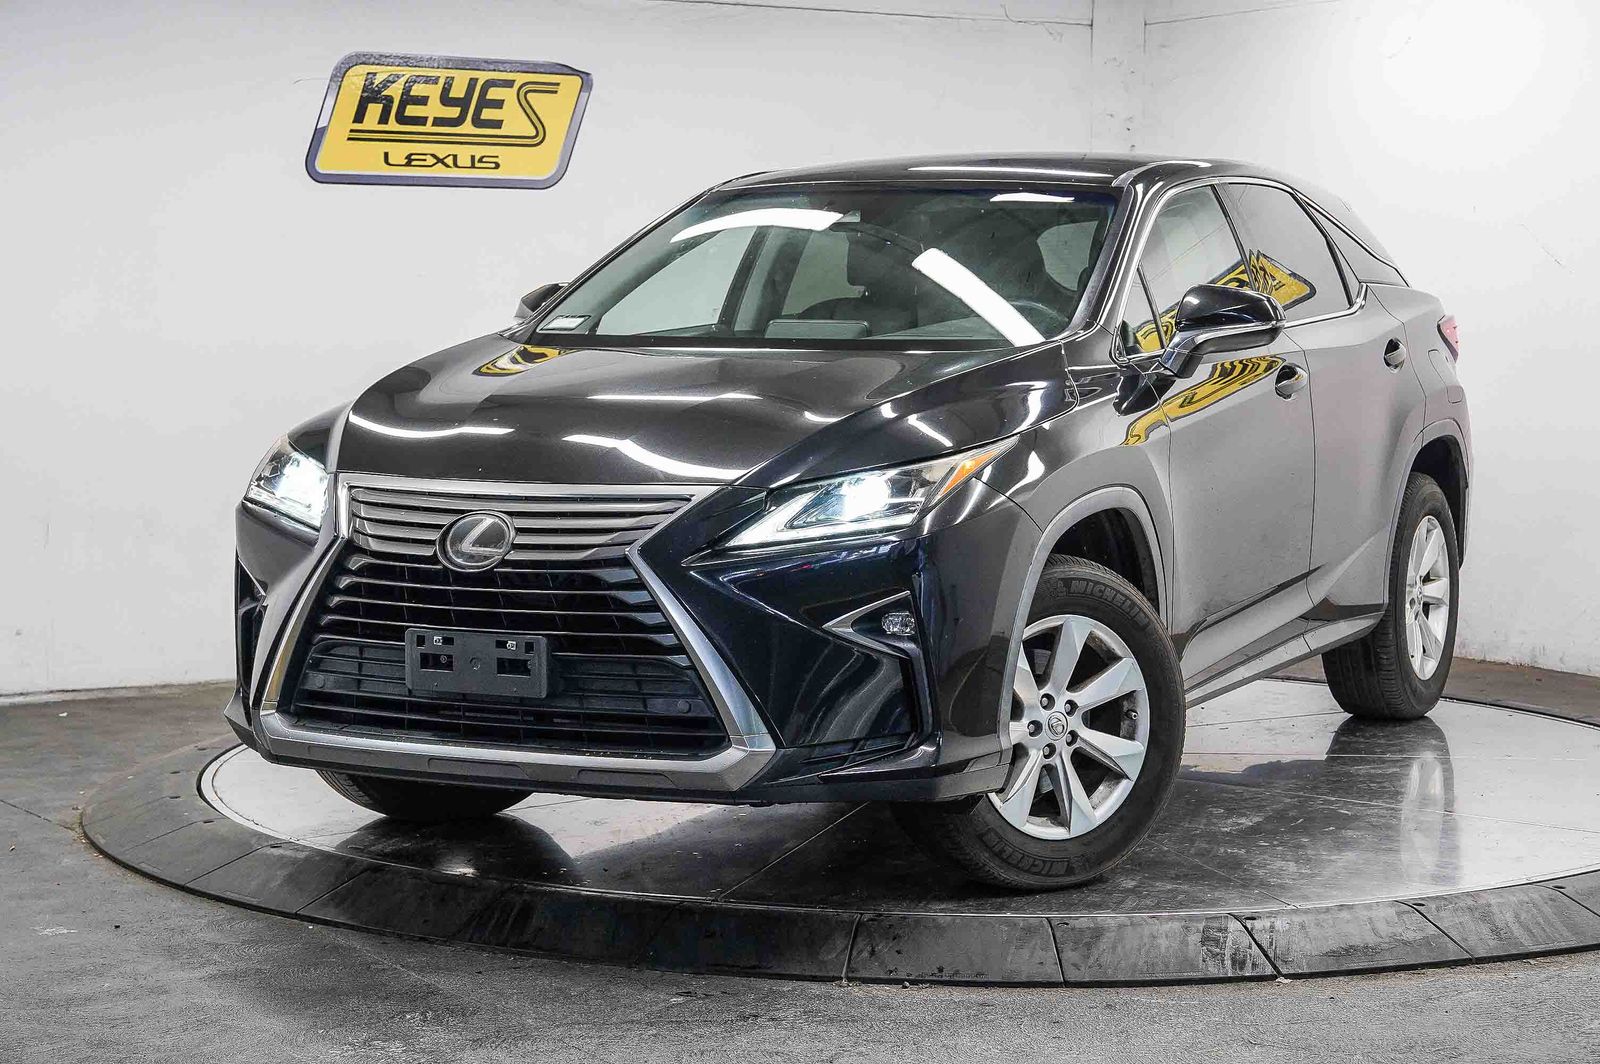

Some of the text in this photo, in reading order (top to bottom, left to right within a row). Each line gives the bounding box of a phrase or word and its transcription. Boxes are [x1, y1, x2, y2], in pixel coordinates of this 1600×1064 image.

[350, 71, 560, 146] KEYES
[384, 151, 500, 170] LEXUS
[1070, 580, 1149, 625] MICHELIN
